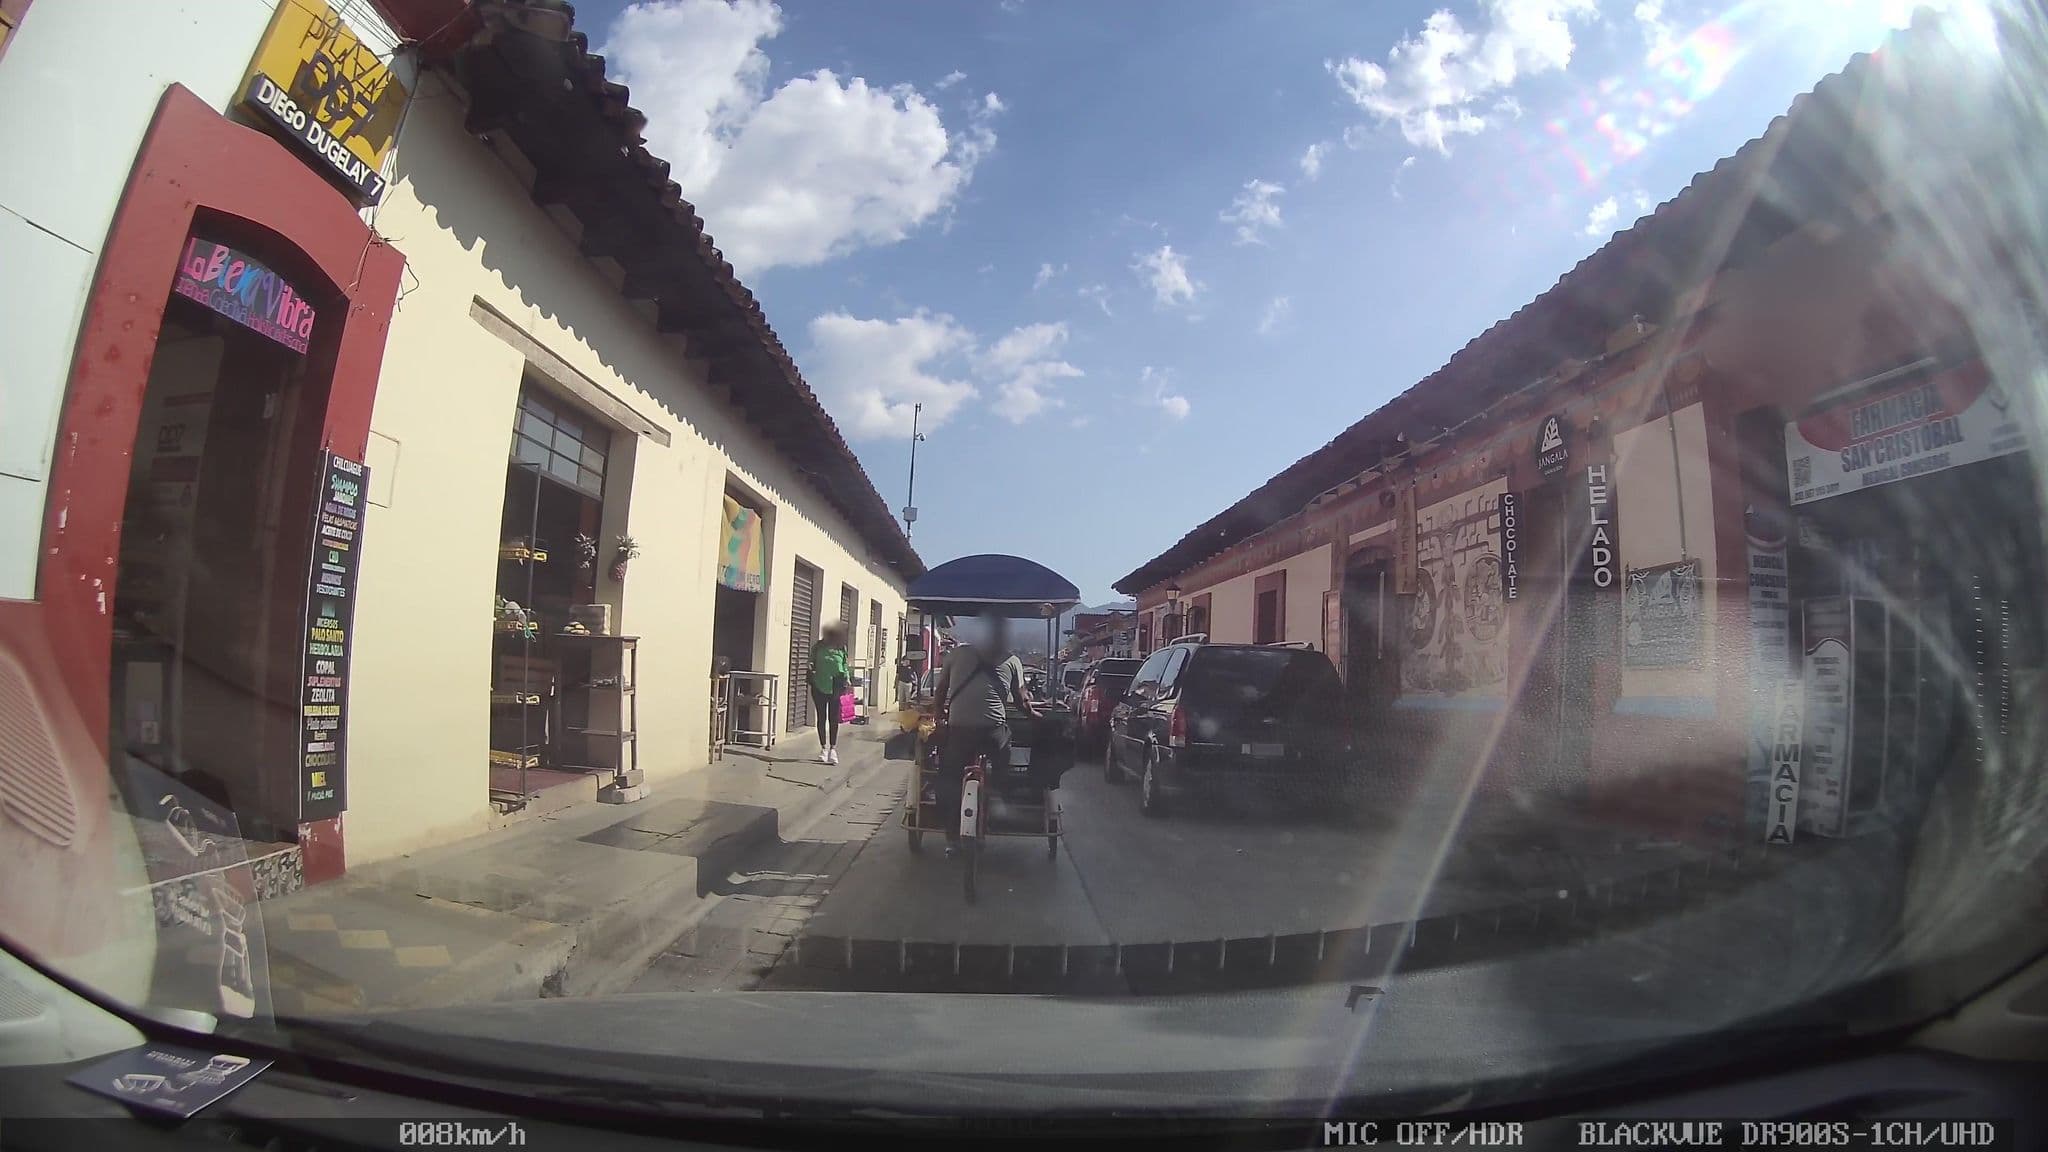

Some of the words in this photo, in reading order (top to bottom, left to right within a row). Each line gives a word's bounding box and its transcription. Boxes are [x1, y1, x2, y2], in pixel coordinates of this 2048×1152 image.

[257, 79, 306, 131] DIEGO
[306, 120, 370, 186] DUGELAY
[371, 177, 385, 196] 7
[1851, 383, 1944, 438] FARMACIA
[1841, 443, 1871, 473] SAN
[1504, 494, 1518, 599] CHOCOLATE
[1587, 465, 1613, 587] HELADO
[311, 627, 326, 641] PALO
[326, 629, 344, 643] SANTO
[316, 660, 335, 674] COPAL
[311, 688, 335, 702] ZEOLITA
